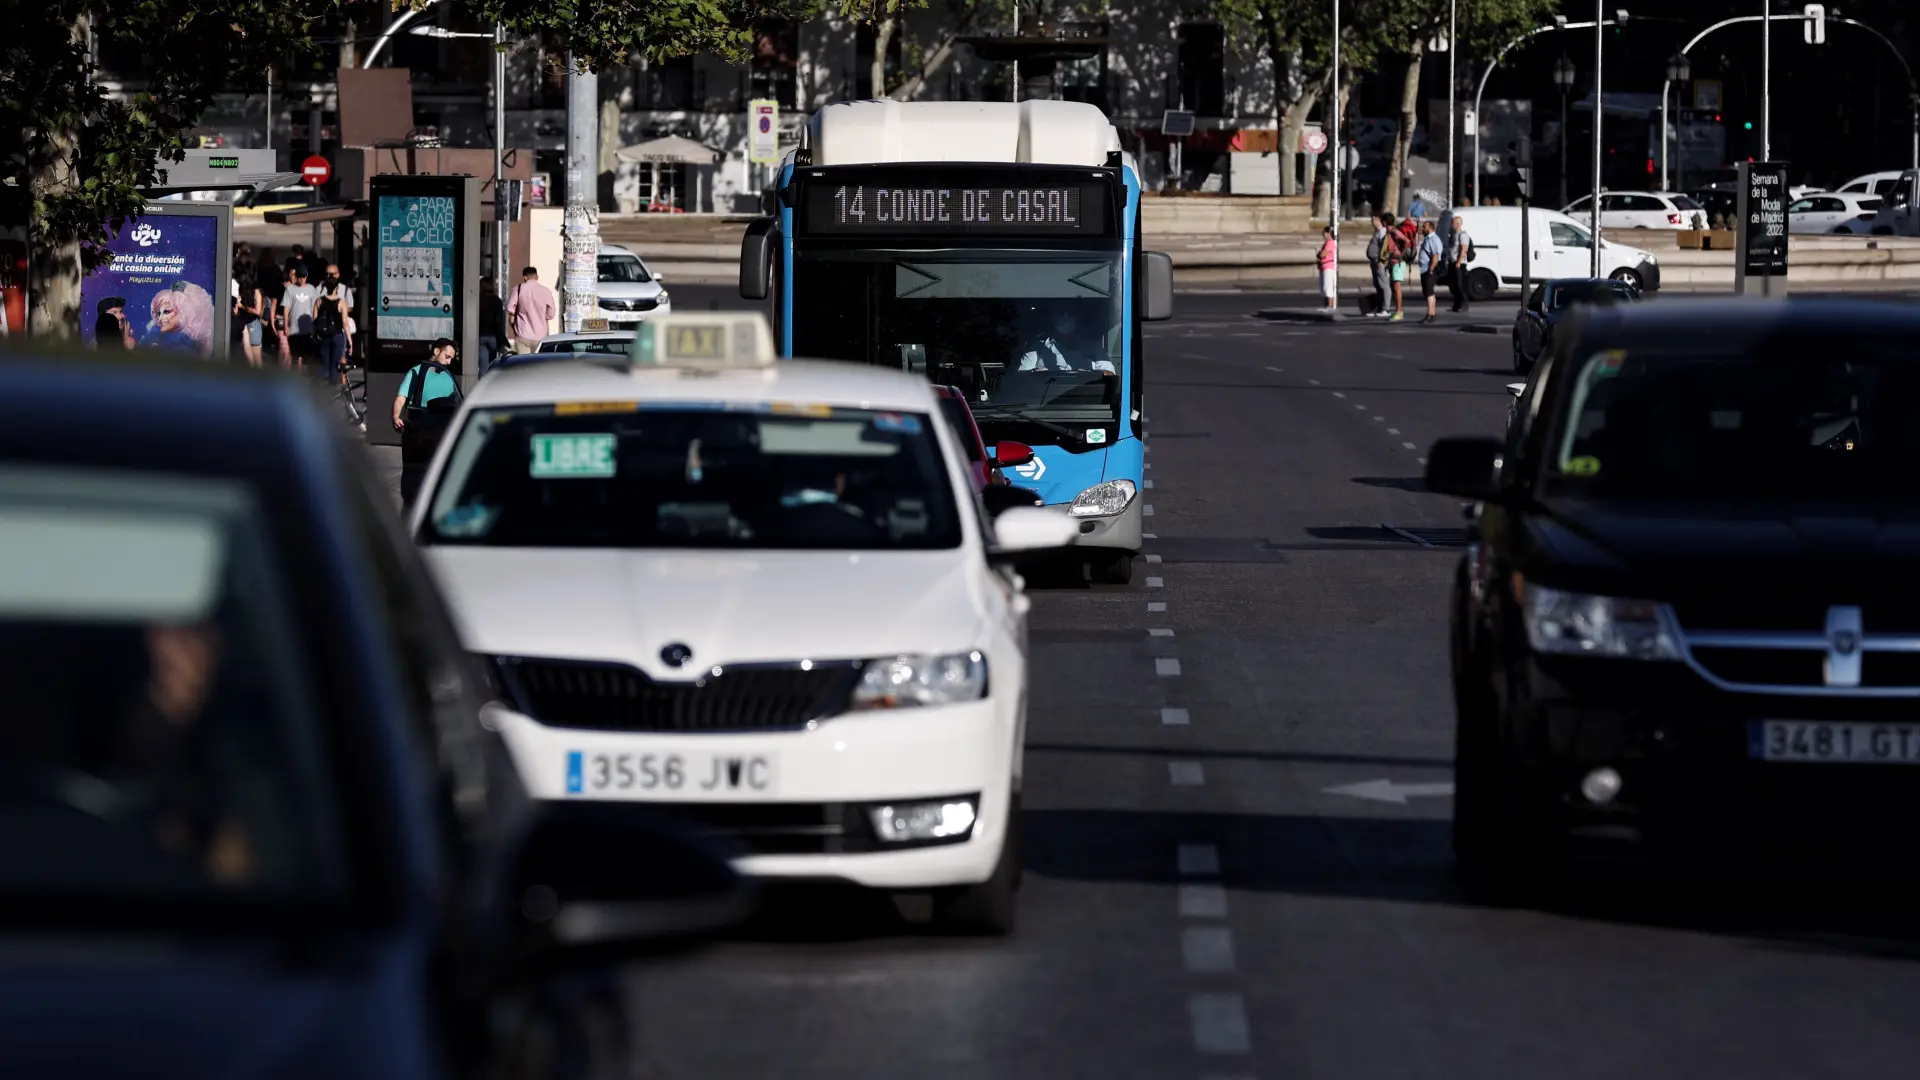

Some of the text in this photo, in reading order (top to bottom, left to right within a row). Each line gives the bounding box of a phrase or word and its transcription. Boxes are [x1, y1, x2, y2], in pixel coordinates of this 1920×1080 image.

[1752, 173, 1778, 185] Semana
[1752, 186, 1768, 198] de la
[419, 197, 455, 213] PARA
[834, 185, 1077, 223] 14 CONDE DE CASAL
[1760, 199, 1781, 211] Moda
[406, 212, 454, 228] GANAR
[1751, 212, 1784, 224] de Madrid
[381, 226, 454, 244] EL CIELO
[1766, 224, 1784, 236] 2022
[135, 255, 144, 263] la
[145, 255, 185, 264] diversión
[109, 262, 124, 271] del
[125, 264, 153, 272] casino
[534, 437, 612, 474] LIBRE
[1770, 724, 1920, 760] 3481 GT
[592, 754, 769, 791] 3556 JWC
